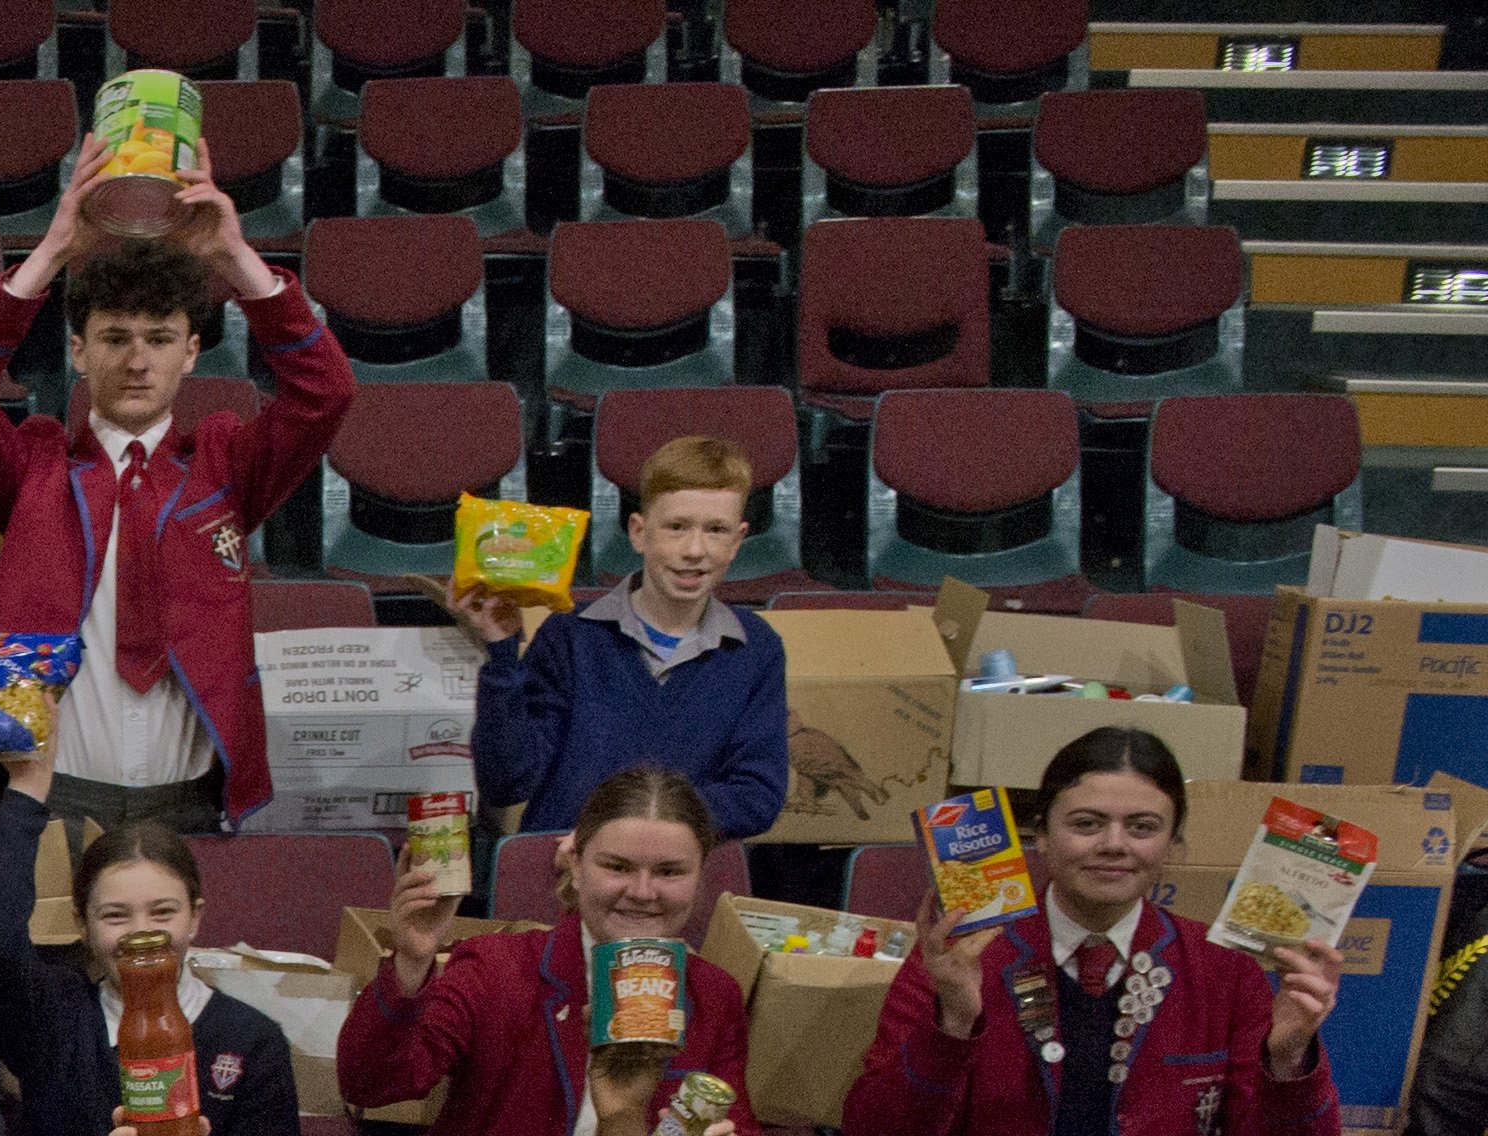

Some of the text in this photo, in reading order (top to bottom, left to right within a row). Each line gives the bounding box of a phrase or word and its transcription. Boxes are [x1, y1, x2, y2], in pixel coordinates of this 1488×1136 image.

[1324, 612, 1374, 635] DJ2
[282, 643, 371, 656] KEEP FROZEN
[1419, 656, 1481, 678] Pacific
[285, 675, 374, 687] HANDLE WITH CARE
[281, 689, 380, 704] DON'T DROP
[293, 728, 362, 742] CRINKLE CUT
[954, 823, 989, 840] Rice
[948, 833, 1003, 857] Risotto
[615, 977, 678, 1001] BEANZ
